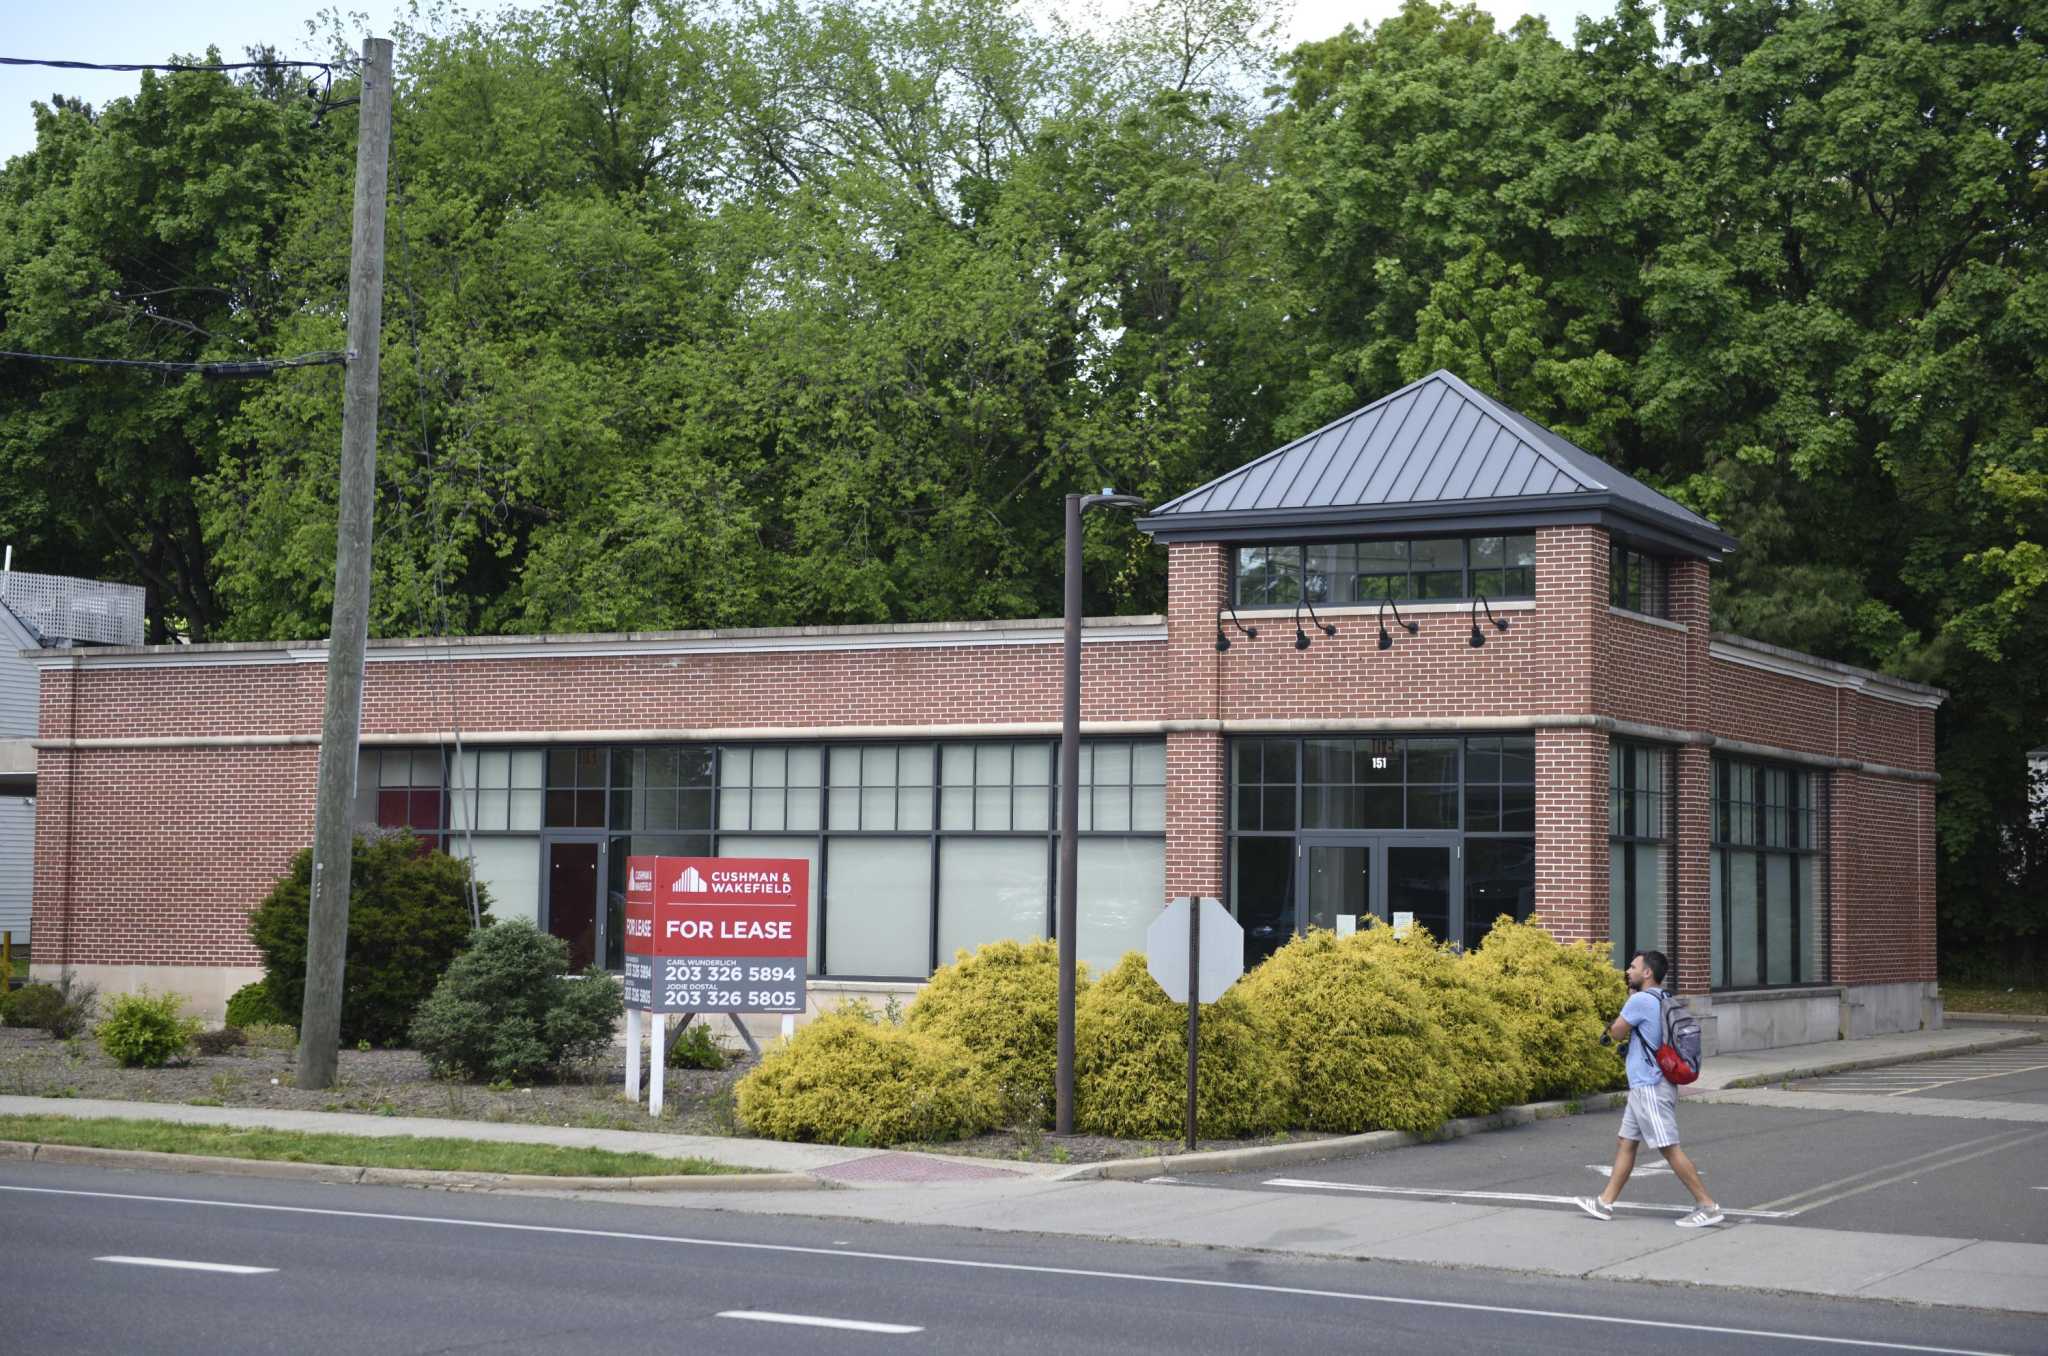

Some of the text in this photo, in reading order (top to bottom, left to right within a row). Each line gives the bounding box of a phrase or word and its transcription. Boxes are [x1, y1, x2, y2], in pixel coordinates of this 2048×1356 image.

[1372, 757, 1387, 769] 151
[712, 872, 791, 882] CUSHMAN &
[712, 883, 792, 894] WAKEFIELD
[636, 920, 652, 937] LEASE
[666, 920, 792, 939] FOR LEASE
[664, 966, 796, 982] 203 326 5894
[664, 991, 796, 1006] 203 326 5805
